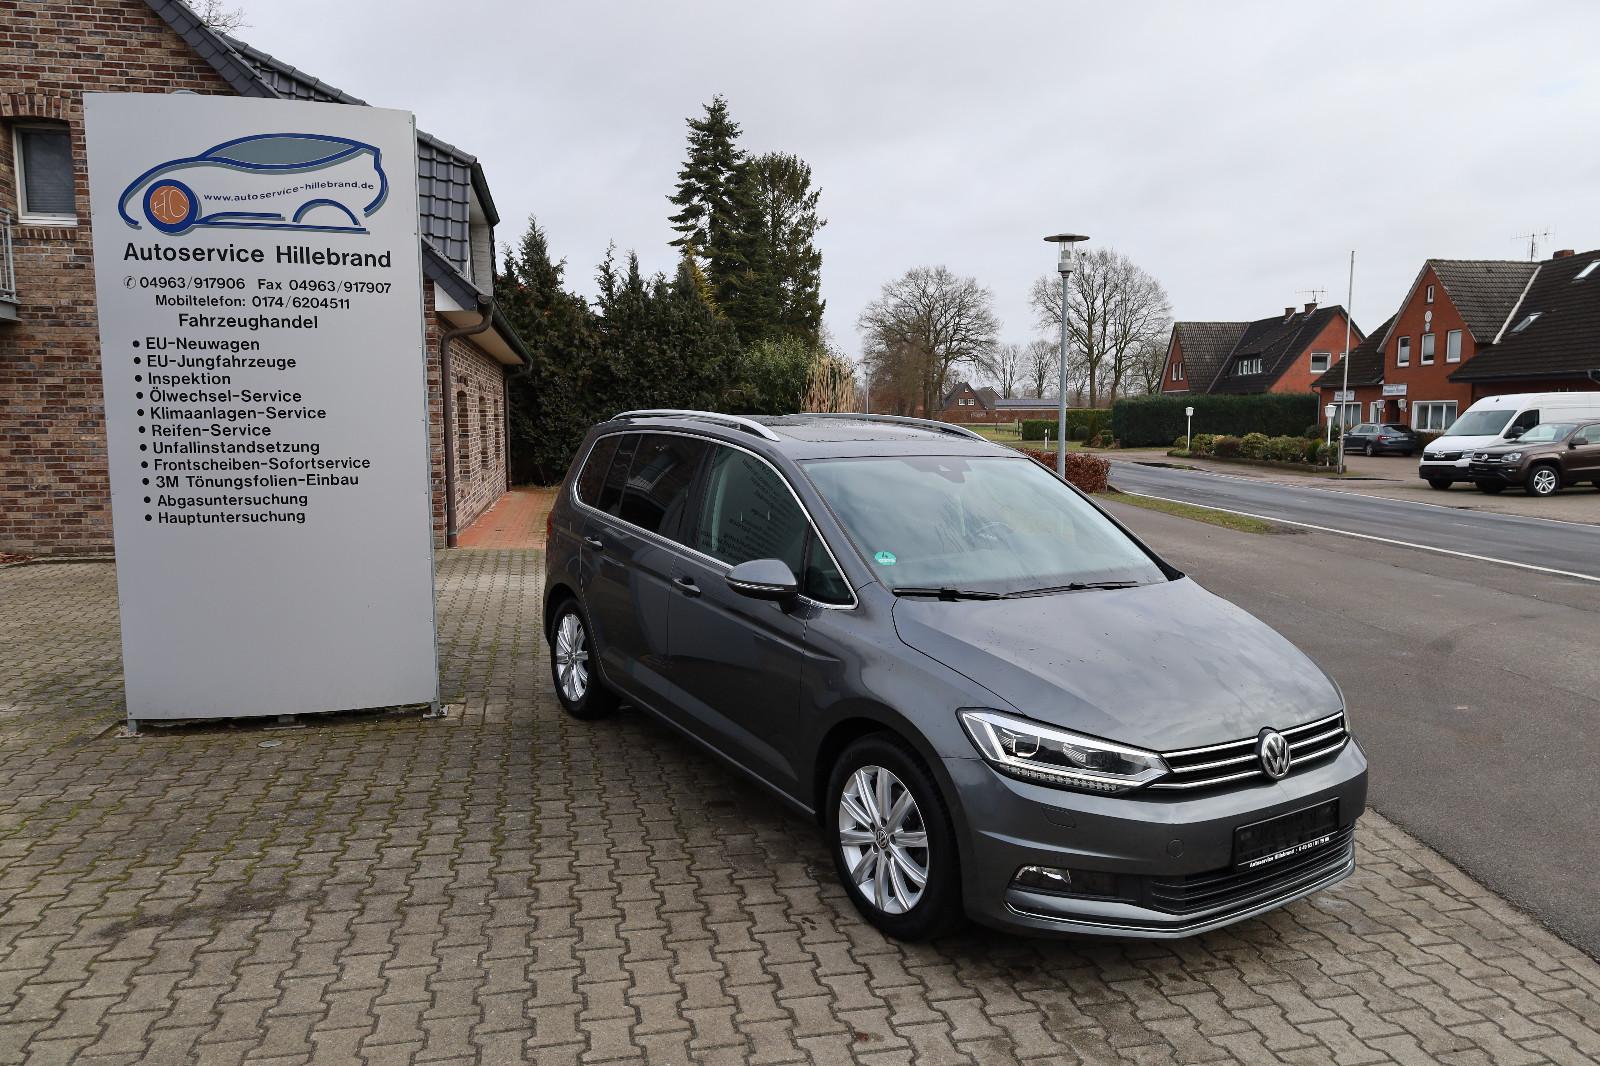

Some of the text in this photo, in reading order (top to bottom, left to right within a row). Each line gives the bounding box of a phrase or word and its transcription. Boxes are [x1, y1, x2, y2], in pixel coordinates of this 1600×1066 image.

[203, 181, 374, 201] www.autoservice-hillebrand.de
[123, 242, 392, 268] Autoservice Hillebrand
[139, 276, 392, 294] 04963/917906 Fax 04963/917907
[155, 294, 350, 310] Mobiltelefon: 0174/6204511
[178, 313, 318, 332] Fahrzeughandel
[145, 336, 260, 353] EU-Neuwagen
[146, 354, 297, 370] EU-Jungfahrzeuge
[147, 371, 231, 387] Inspektion
[149, 386, 302, 402] Ölwechsel-Service
[149, 406, 327, 422] Klimaanlagen-Service
[151, 423, 272, 437] Reifen-Service
[152, 441, 320, 455] Unfallinstandsetzung
[153, 456, 371, 471] Frontscheiben-Sofortservice
[155, 473, 359, 491] 3M Tönungsfolien-Einbau
[157, 493, 308, 508] Abgasuntersuchung
[158, 509, 306, 525] Hauptuntersuchung
